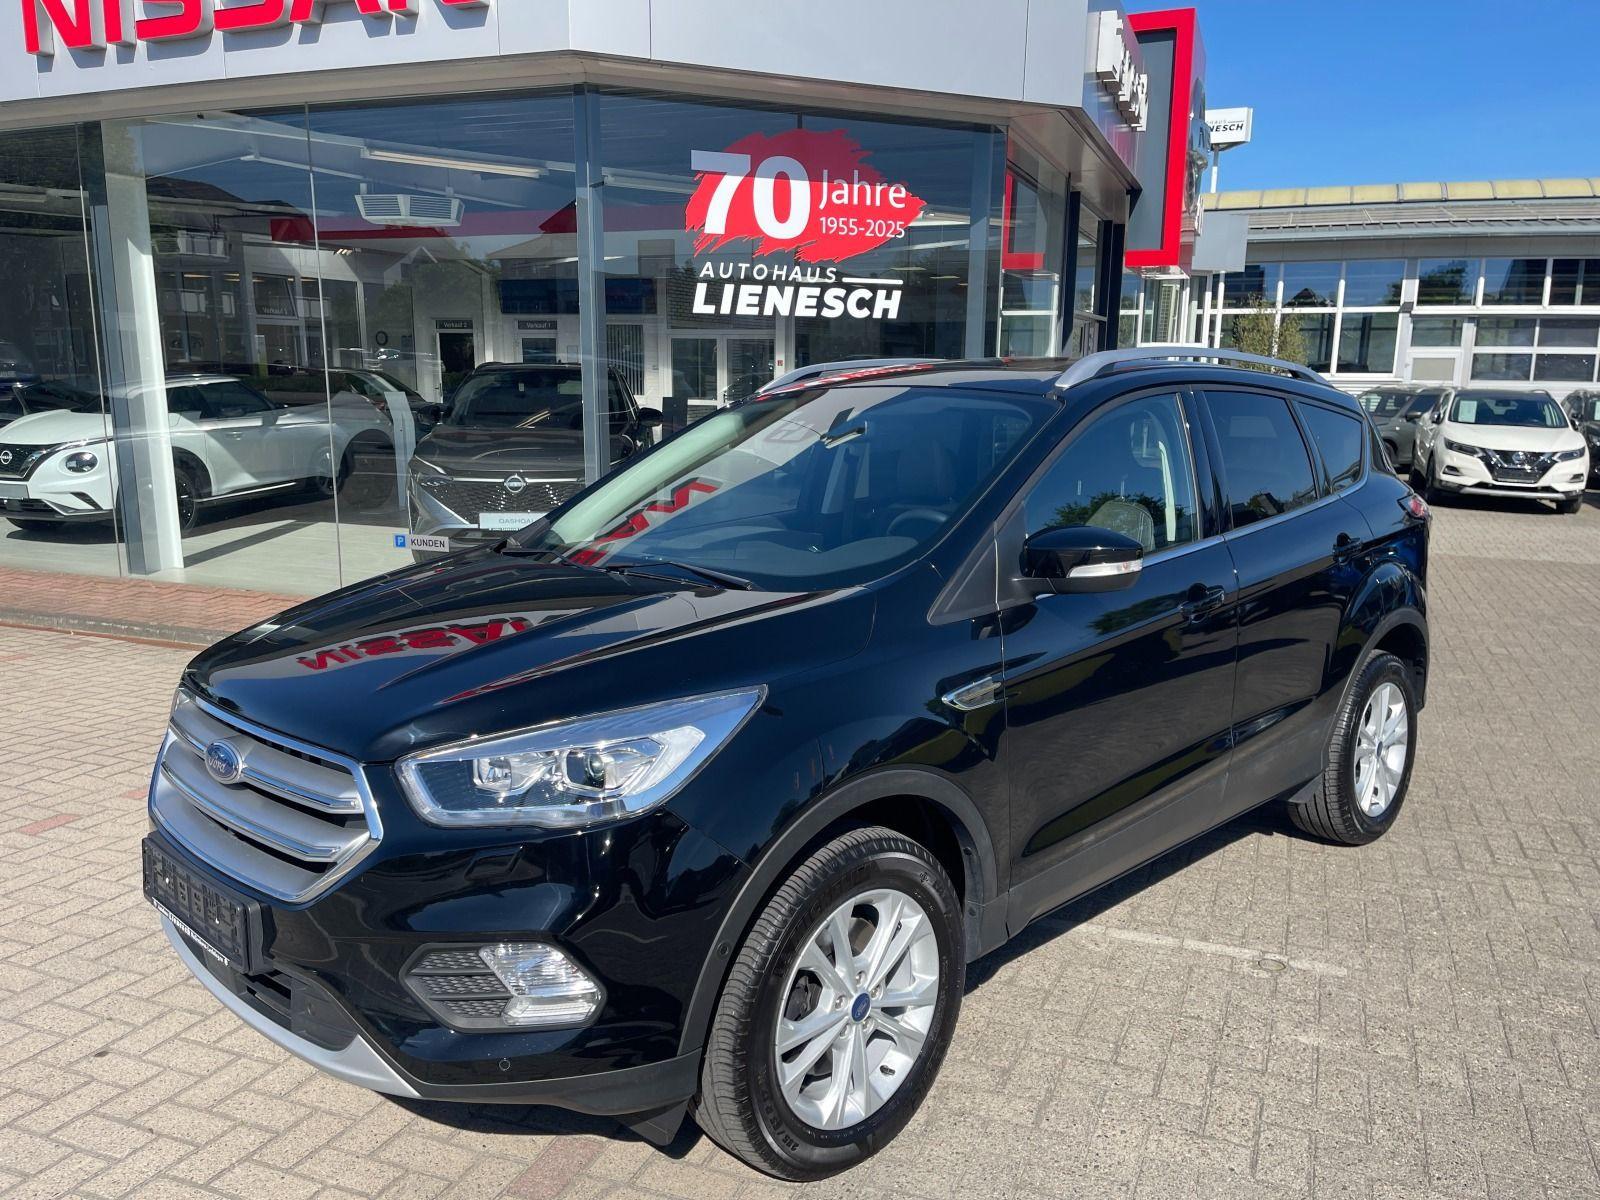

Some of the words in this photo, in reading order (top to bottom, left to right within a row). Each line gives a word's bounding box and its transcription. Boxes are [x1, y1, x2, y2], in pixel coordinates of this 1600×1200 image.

[1209, 123, 1244, 132] NESCH
[691, 150, 811, 239] 70
[818, 169, 906, 209] Jahre
[819, 217, 905, 239] 1955-2025
[700, 261, 837, 283] AUTOHAUS
[692, 283, 902, 319] LIENESCH
[411, 538, 445, 548] KUNDEN
